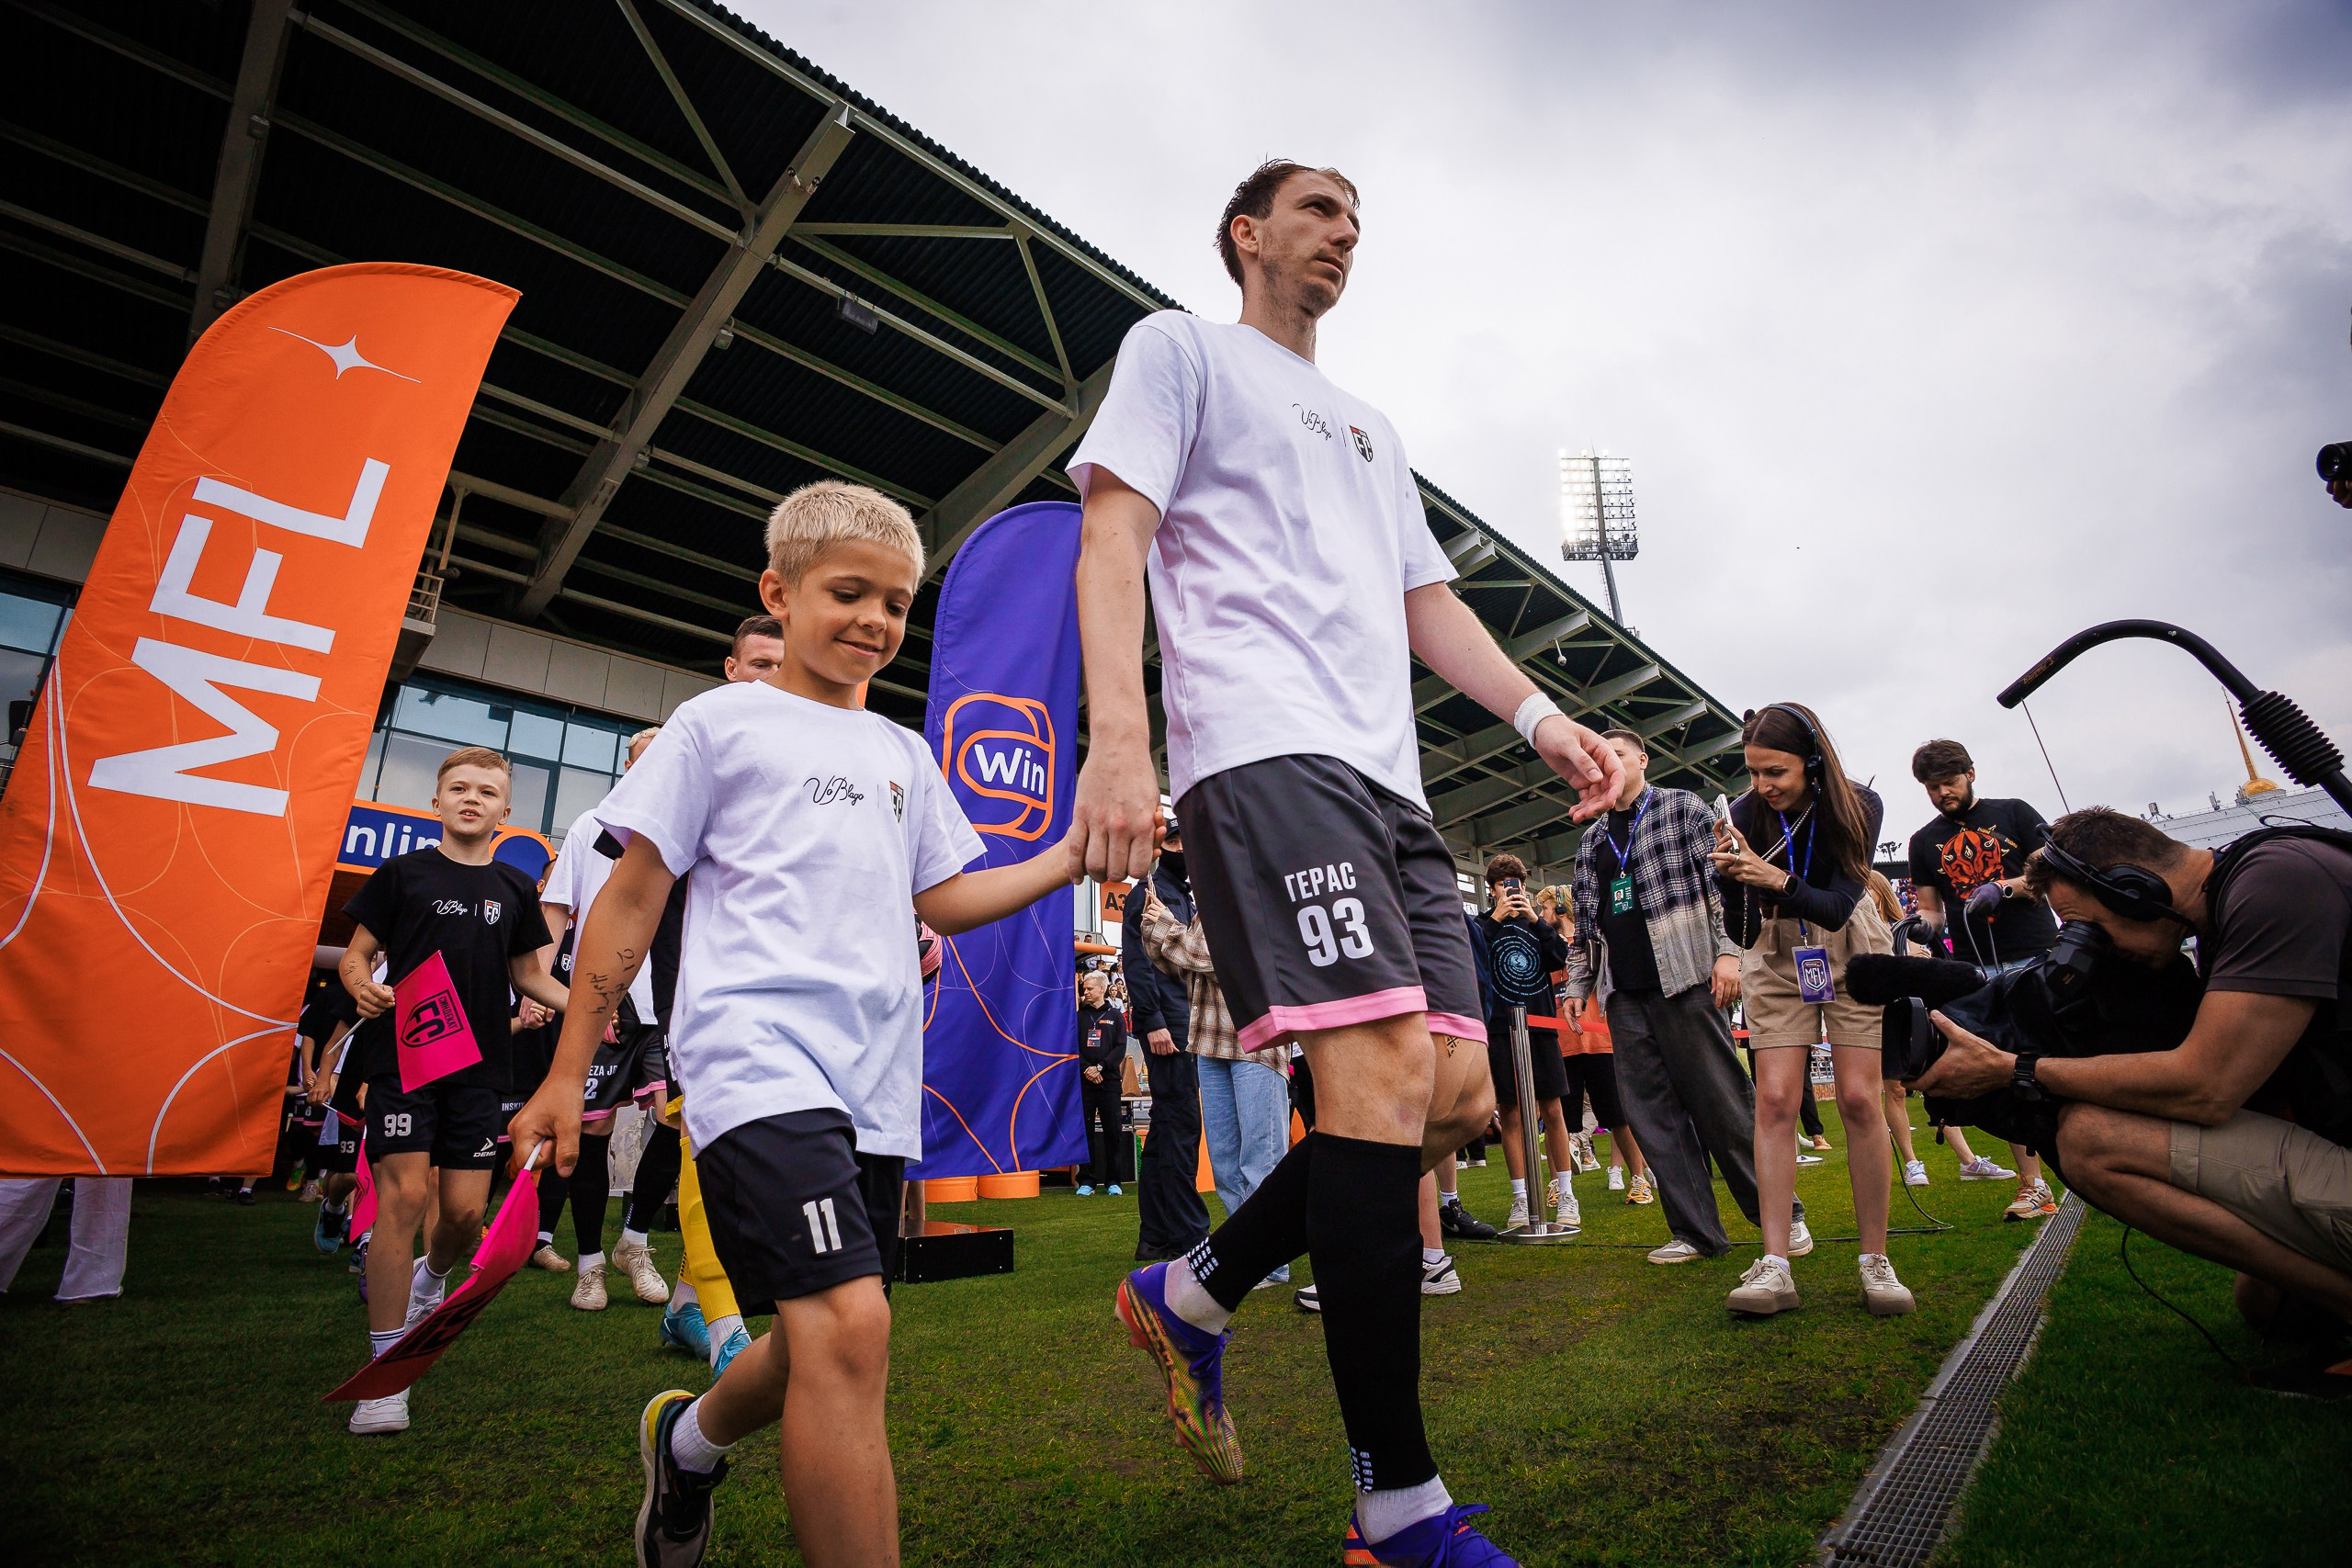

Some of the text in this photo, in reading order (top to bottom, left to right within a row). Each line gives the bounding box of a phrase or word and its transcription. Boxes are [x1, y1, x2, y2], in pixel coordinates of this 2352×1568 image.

[87, 457, 390, 818] MFL
[974, 743, 1045, 795] Win
[1284, 862, 1357, 902] ГЕРАС
[1296, 897, 1374, 967] 93
[583, 1077, 599, 1100] 2
[384, 1113, 412, 1137] 99
[802, 1198, 842, 1254] 11
